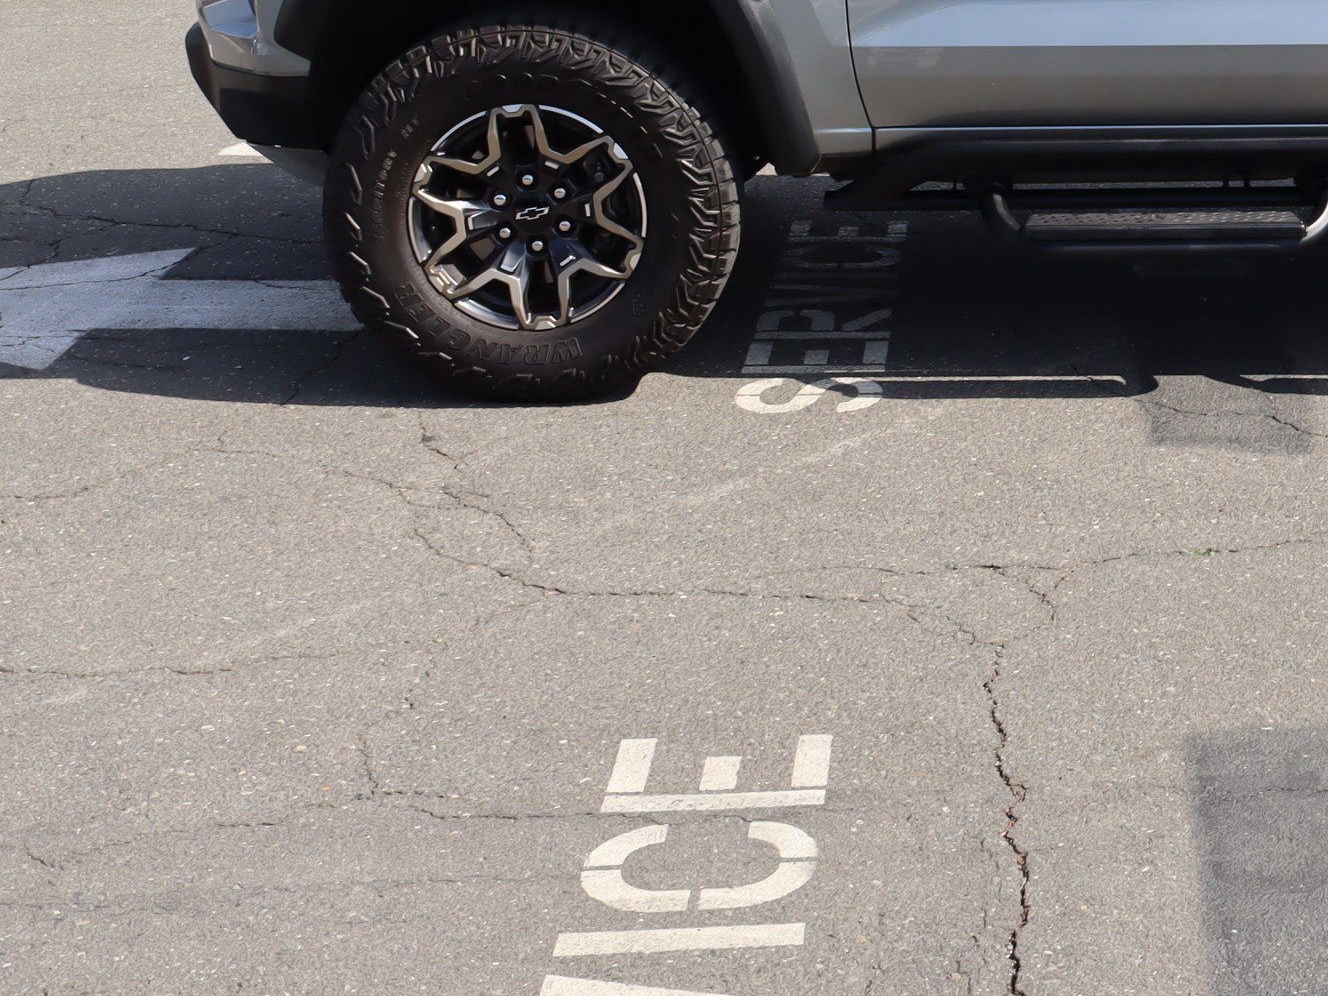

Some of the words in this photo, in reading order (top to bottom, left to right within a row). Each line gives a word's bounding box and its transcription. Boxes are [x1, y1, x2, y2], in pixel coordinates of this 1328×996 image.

[393, 281, 584, 366] WRANGLER
[735, 220, 909, 414] SERVICE
[539, 734, 834, 996] ICE
